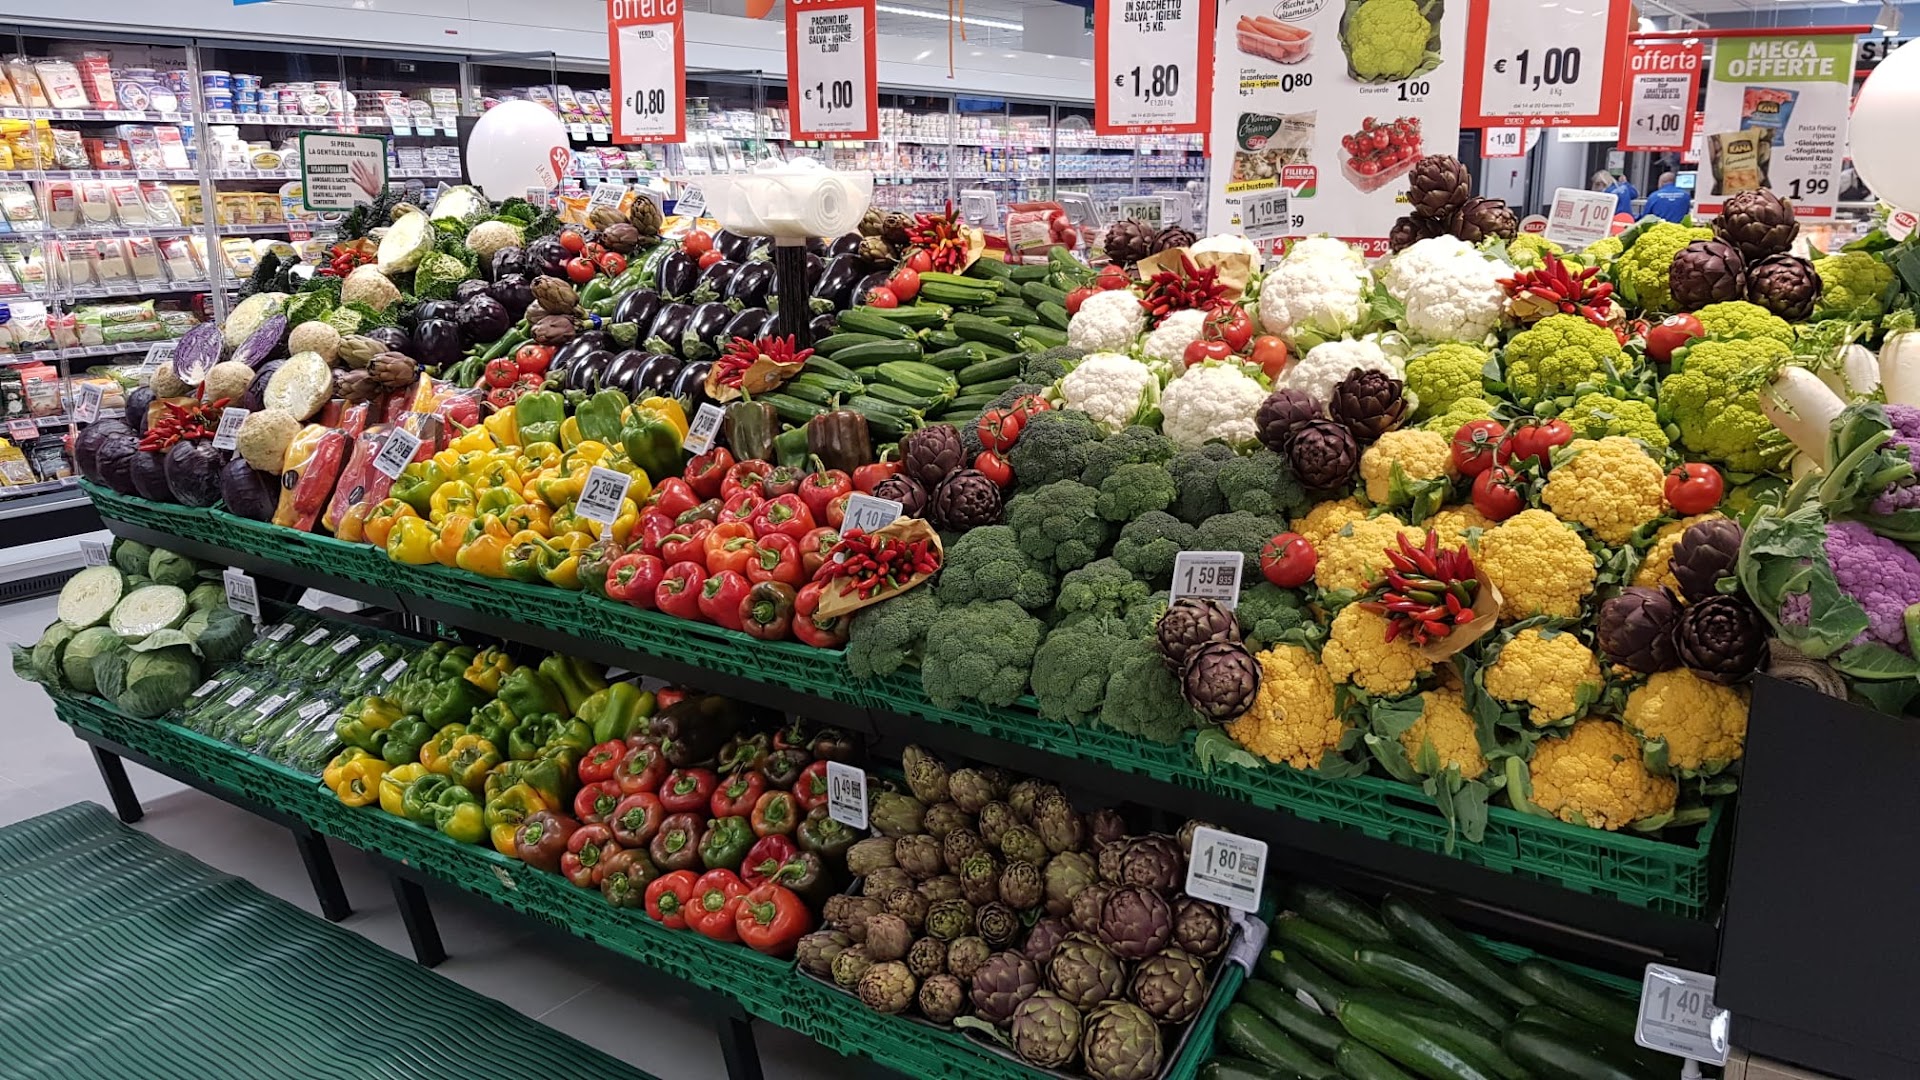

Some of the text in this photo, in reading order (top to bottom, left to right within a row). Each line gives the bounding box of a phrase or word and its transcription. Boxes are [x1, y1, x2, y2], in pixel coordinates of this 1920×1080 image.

[1124, 12, 1148, 22] SALVA
[1156, 10, 1182, 20] IGIENE
[1126, 0, 1182, 12] IN SACCHETTO
[1279, 3, 1319, 19] vitamina A
[809, 24, 852, 35] IN CONFEZIONE
[811, 16, 836, 25] PACHINO
[1138, 21, 1166, 34] 1,5 KG.
[809, 36, 827, 44] SALVA
[1747, 40, 1818, 59] MEGA
[1494, 47, 1581, 91] € 1,00
[1631, 50, 1697, 70] offerta
[1728, 57, 1835, 77] OFFERTE
[1114, 64, 1179, 103] € 1,80
[1260, 80, 1280, 89] igiene
[1282, 73, 1313, 93] 0,80
[626, 88, 665, 119] € 0,80
[805, 80, 853, 113] € 1,00
[1637, 118, 1643, 127] €
[1647, 114, 1680, 135] 1,00
[1497, 133, 1516, 146] 1,00
[1247, 181, 1274, 190] bustone
[1789, 178, 1829, 201] 1,99
[1249, 201, 1272, 224] 1,10
[1580, 203, 1609, 227] 1,00
[1373, 241, 1389, 251] 20
[1184, 566, 1215, 594] 1,59
[1219, 575, 1233, 585] 935
[834, 776, 851, 802] 0,49
[1204, 846, 1237, 876] 1,80
[1658, 986, 1700, 1022] 1,40
